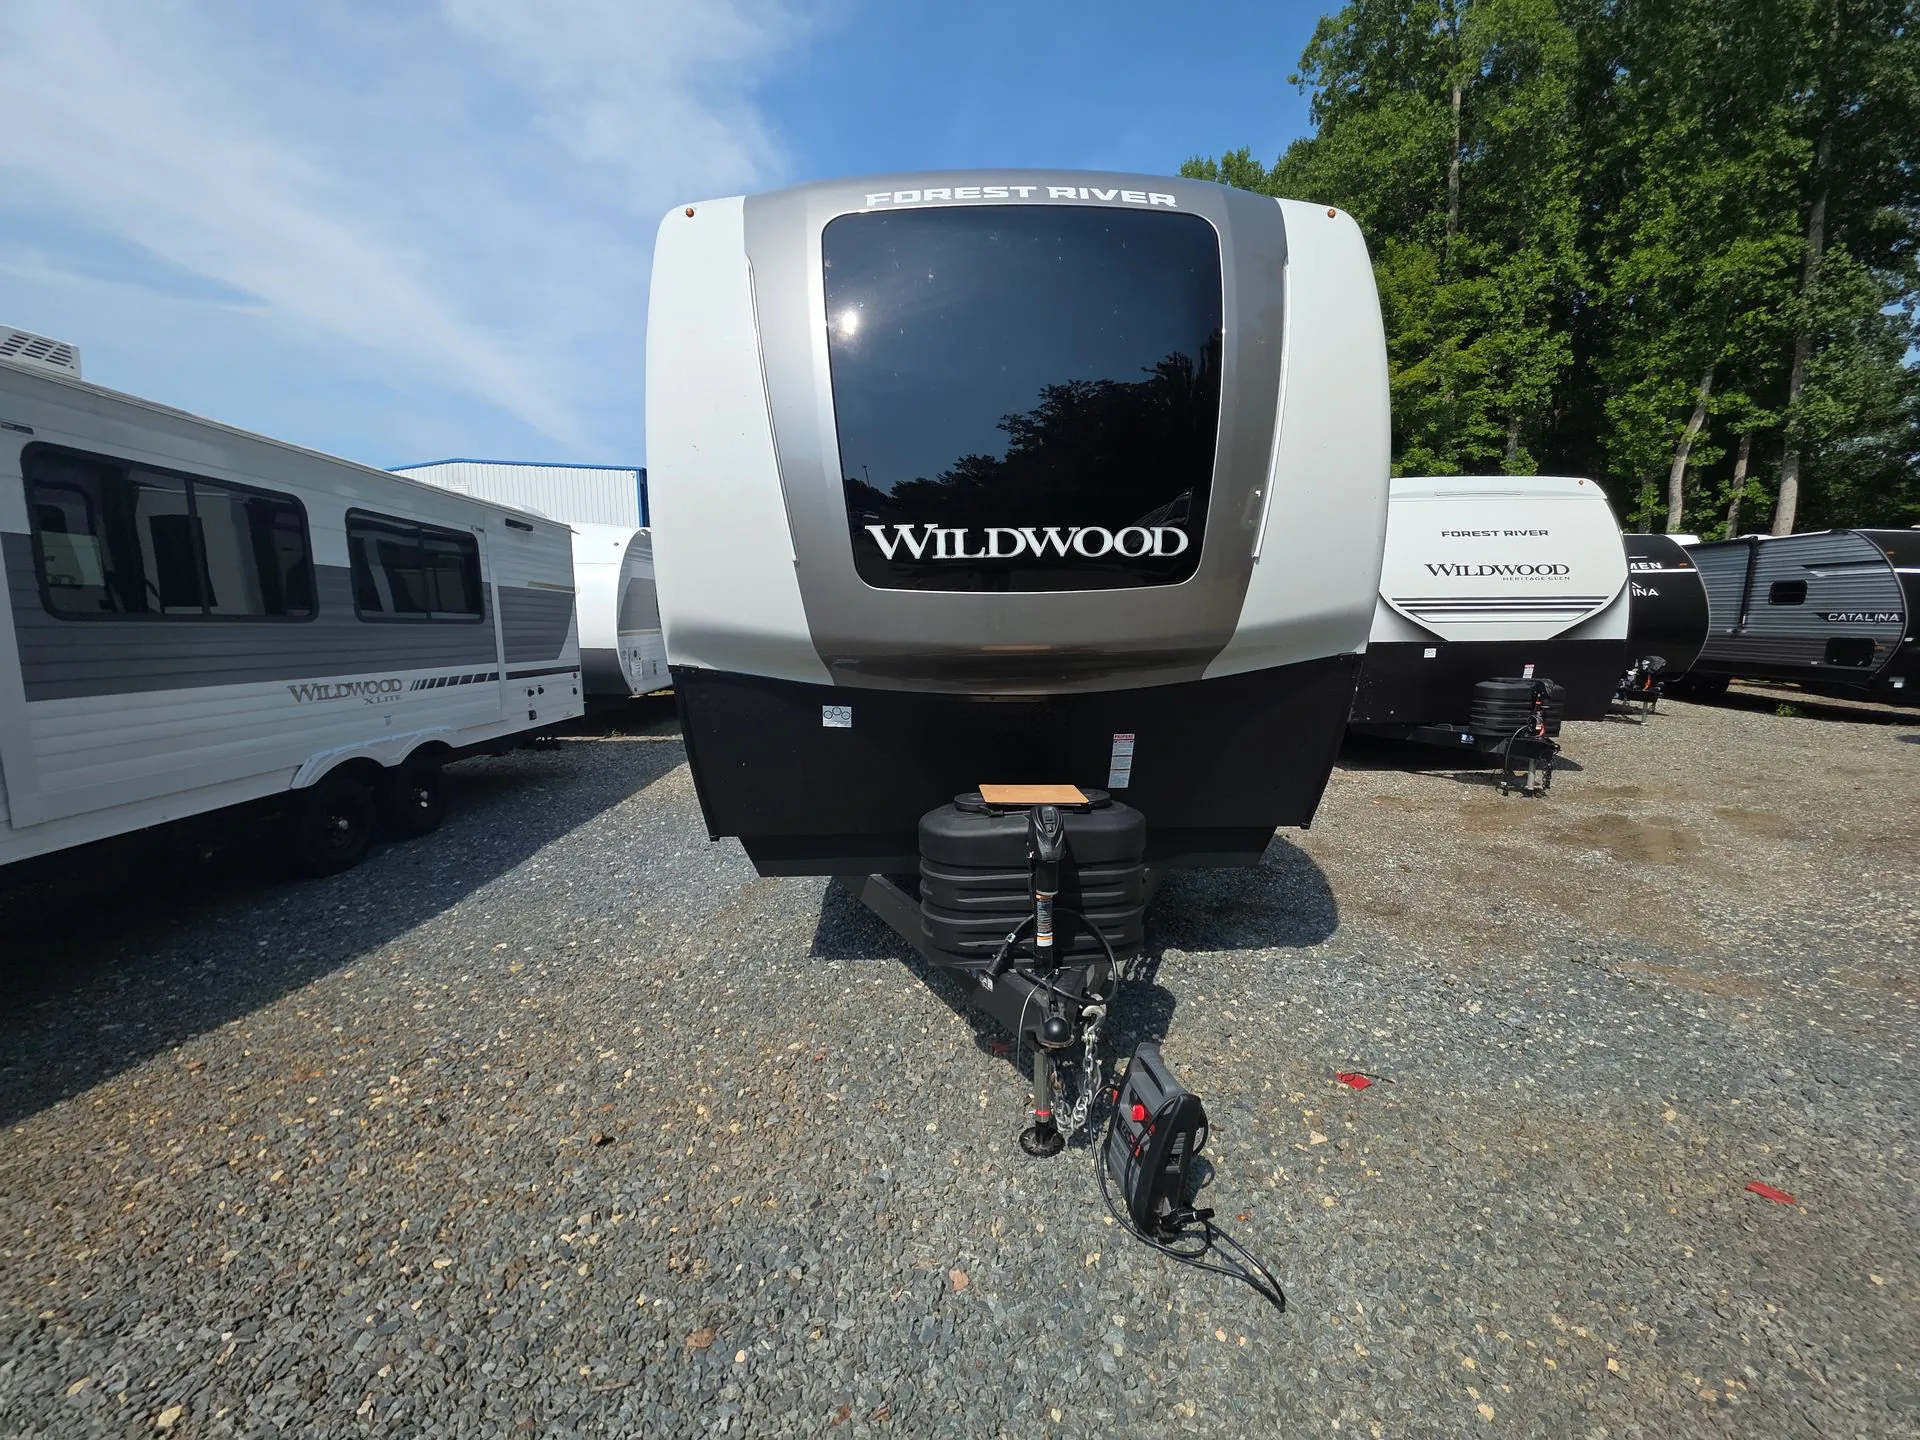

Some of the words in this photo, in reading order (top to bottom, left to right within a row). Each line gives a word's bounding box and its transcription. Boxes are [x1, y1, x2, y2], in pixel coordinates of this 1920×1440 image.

[865, 186, 1038, 207] FOREST
[1046, 186, 1178, 208] RIVER
[864, 523, 1189, 560] WILDWOOD
[1503, 529, 1549, 537] RIVER
[1424, 563, 1571, 577] WILDWOOD
[1828, 613, 1900, 622] CATALINA
[287, 678, 403, 703] WILDWOOD
